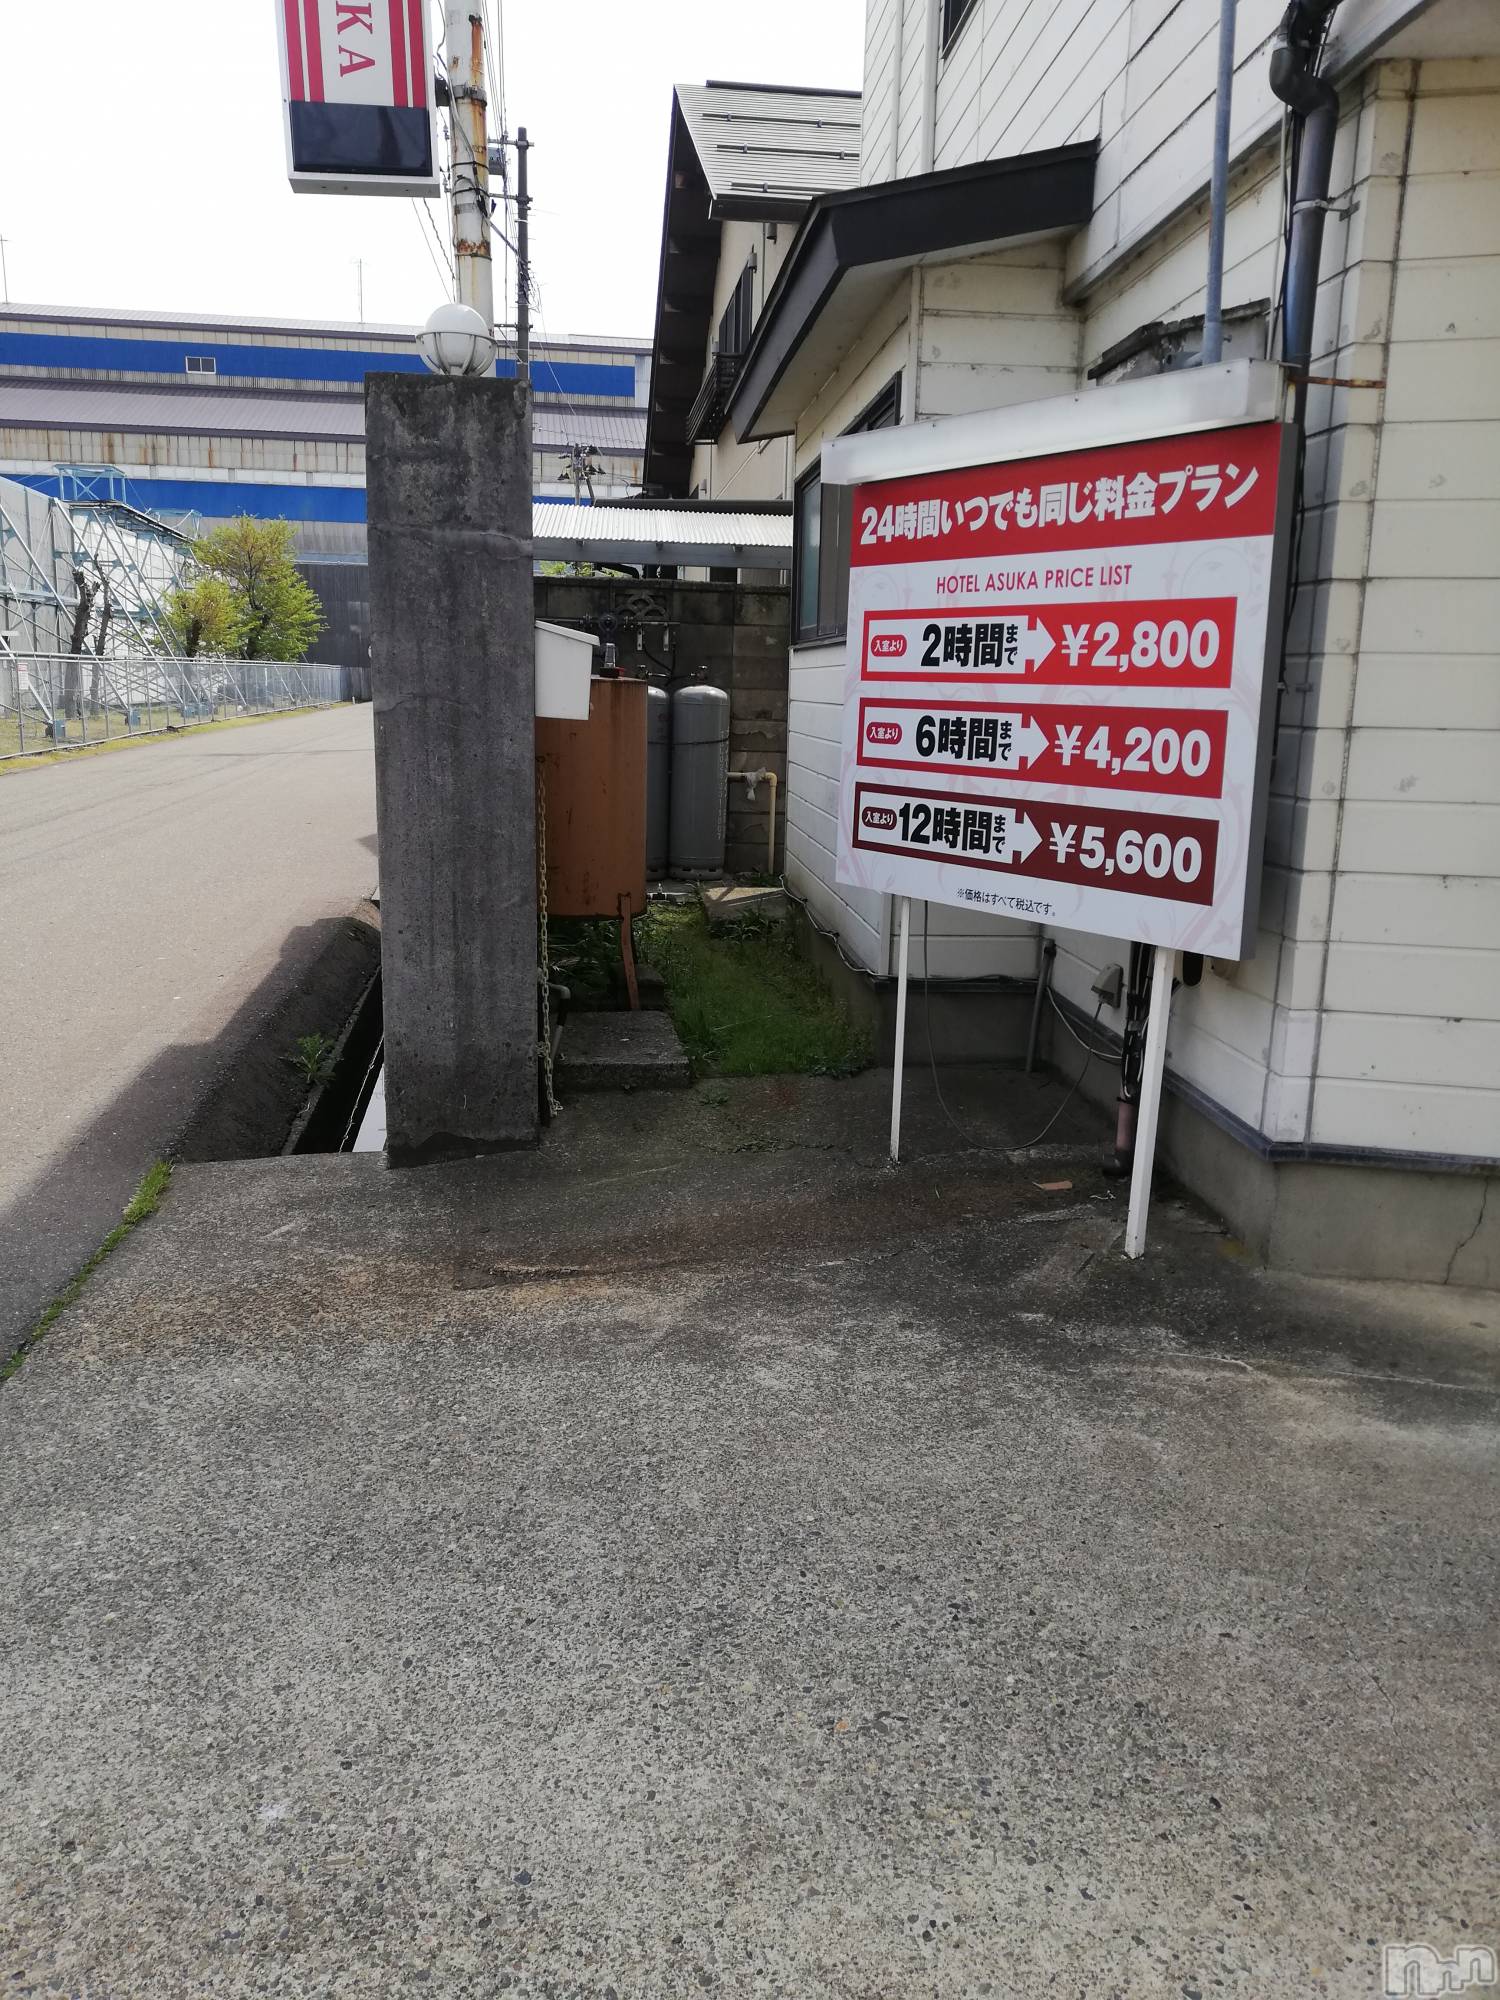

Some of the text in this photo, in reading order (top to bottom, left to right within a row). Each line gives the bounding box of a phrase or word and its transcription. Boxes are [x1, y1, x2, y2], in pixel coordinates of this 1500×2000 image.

[860, 464, 1259, 545] 24時間いつでも同じ料金プラン
[936, 565, 1133, 594] HOTEL ASUKA PRICE LIST
[873, 638, 904, 653] 入室より
[1061, 619, 1220, 673] ¥2,800
[869, 726, 899, 741] 入室より
[1054, 724, 1211, 777] ¥4,200
[864, 811, 894, 826] 入室より
[1049, 822, 1202, 884] ¥5,600
